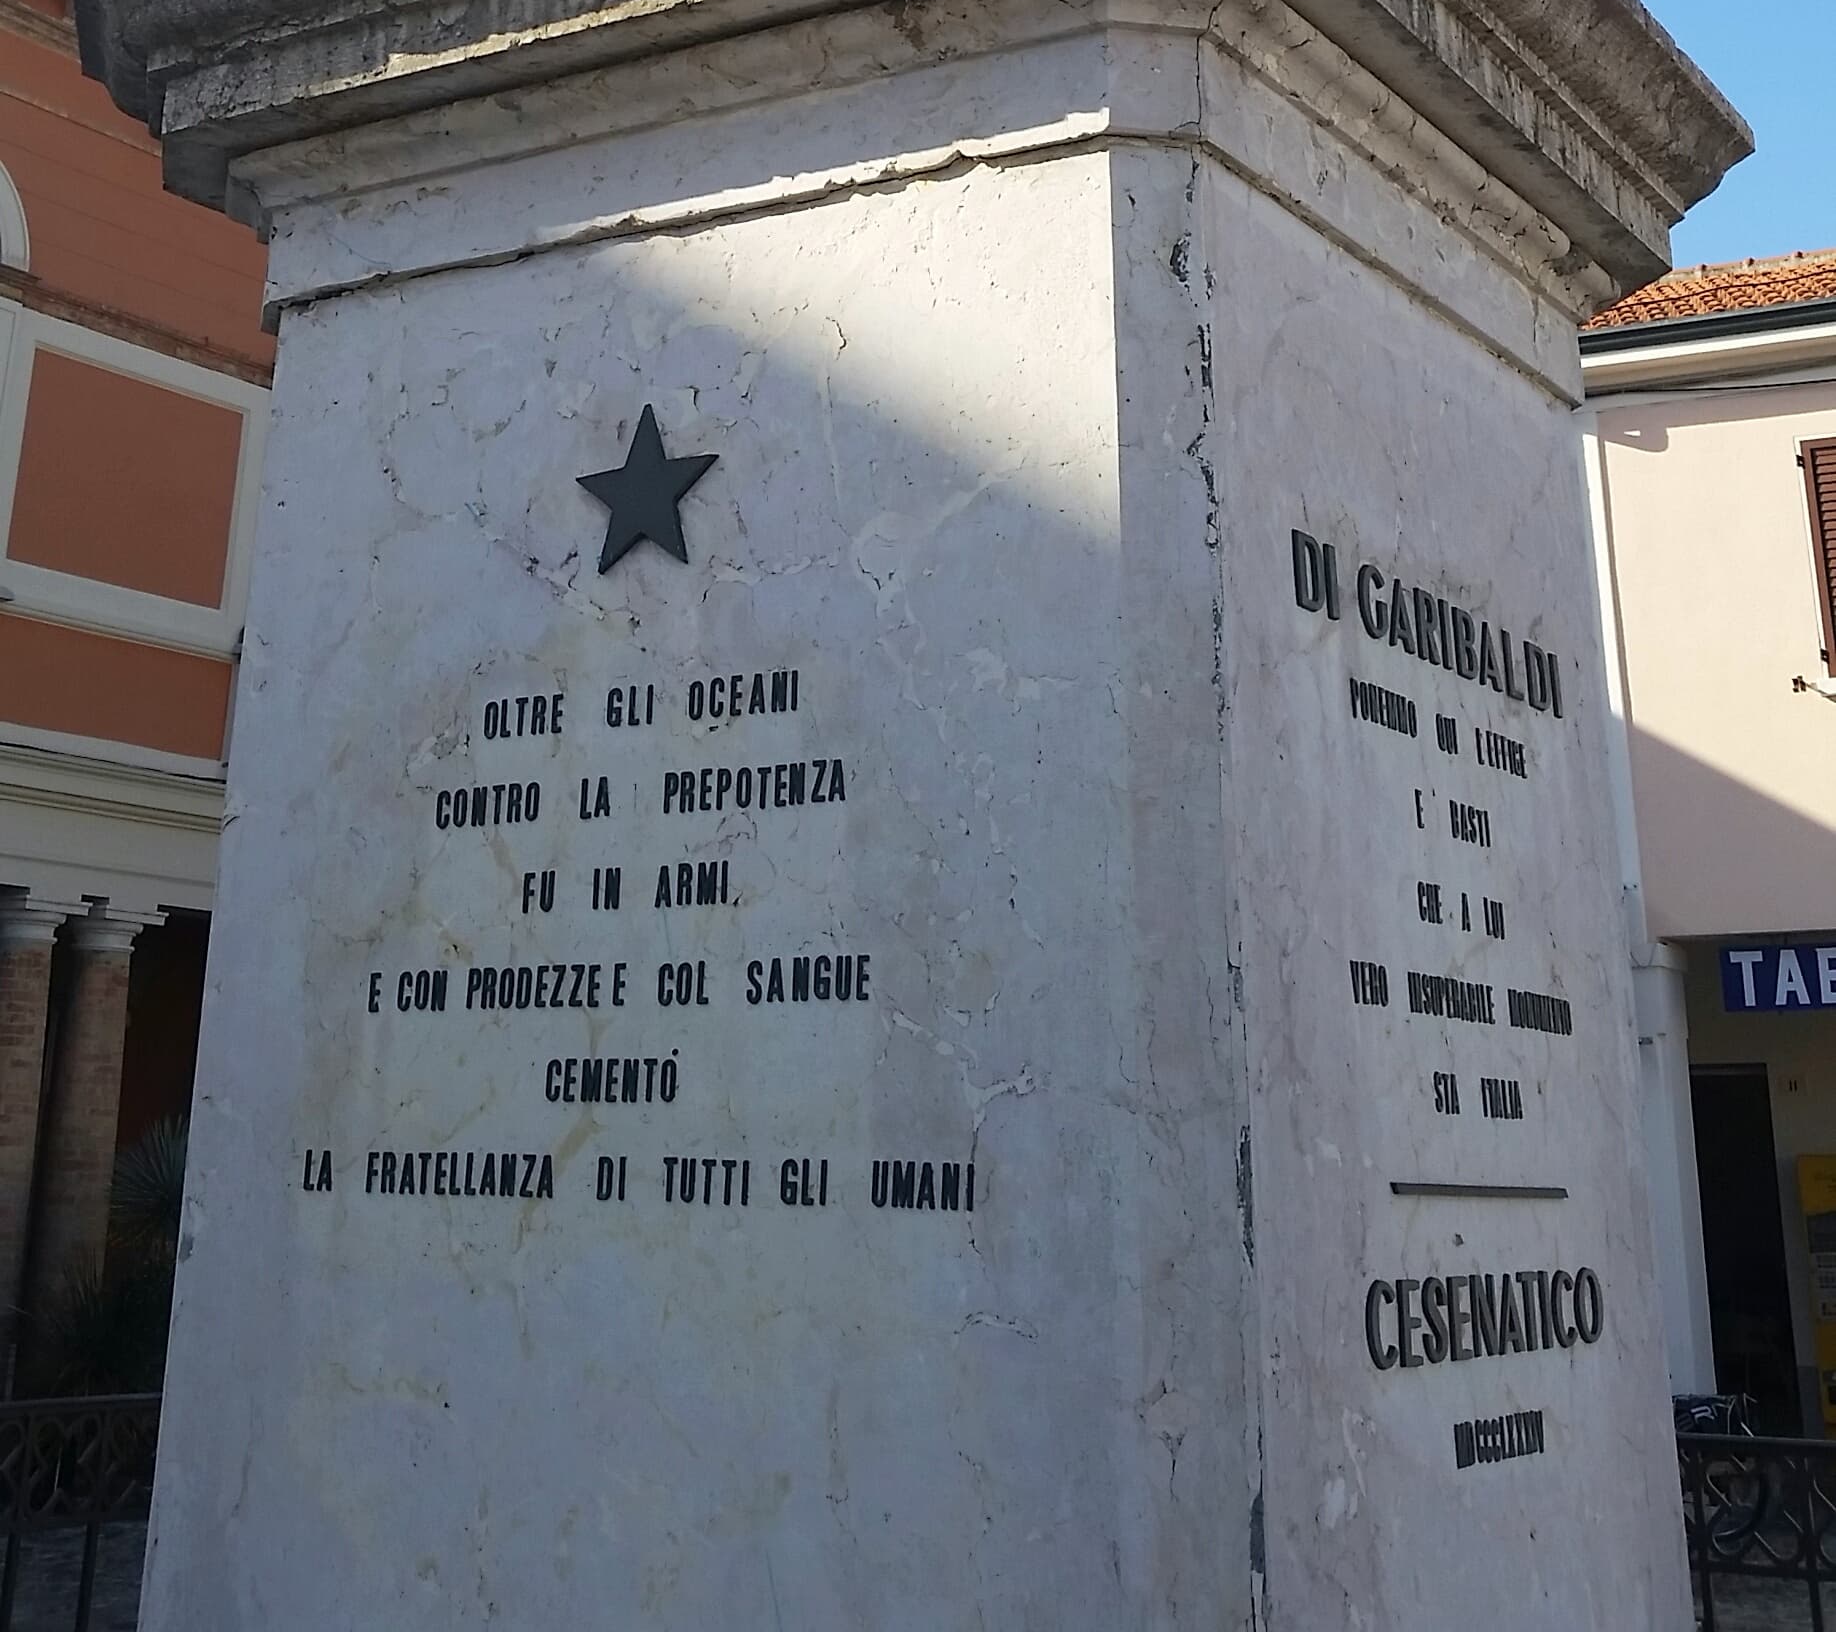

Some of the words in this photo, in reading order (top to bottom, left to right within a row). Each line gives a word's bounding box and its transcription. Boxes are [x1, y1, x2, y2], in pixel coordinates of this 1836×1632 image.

[1291, 528, 1340, 621] DI
[1357, 564, 1563, 718] GARIBALDI
[483, 693, 565, 741] OLTRE
[606, 683, 654, 728] GLI
[688, 669, 799, 721] OCEANI
[1350, 677, 1417, 738] PONEMMO
[1435, 713, 1459, 755] QUI
[435, 781, 541, 831] CONTRO
[579, 776, 611, 821] LA
[663, 758, 846, 815] PREPOTENZA
[1449, 799, 1491, 848] BASTI
[521, 870, 556, 915] FU
[592, 867, 621, 911] IN
[654, 859, 729, 909] ARMI
[1417, 881, 1443, 925] CHE
[1461, 892, 1471, 932] A
[1483, 897, 1505, 940] LUI
[367, 972, 383, 1014] E
[396, 969, 448, 1013] CON
[465, 964, 602, 1010] PRODEZZE
[612, 962, 627, 1007] E
[657, 960, 709, 1007] COL
[746, 954, 871, 1006] SANGUE
[1350, 960, 1388, 1007] VERO
[1407, 971, 1496, 1025] INSUPERABILE
[1507, 988, 1573, 1036] MONUMENTO
[1433, 1071, 1460, 1115] STA
[1480, 1077, 1524, 1120] ITALIA
[302, 1148, 333, 1193] LA
[365, 1151, 554, 1200] FRATELLANZA
[596, 1156, 628, 1202] DI
[662, 1156, 750, 1207] TUTTI
[780, 1158, 828, 1207] GLI
[871, 1158, 976, 1213] UMANI
[1365, 1267, 1604, 1370] CESENATICO
